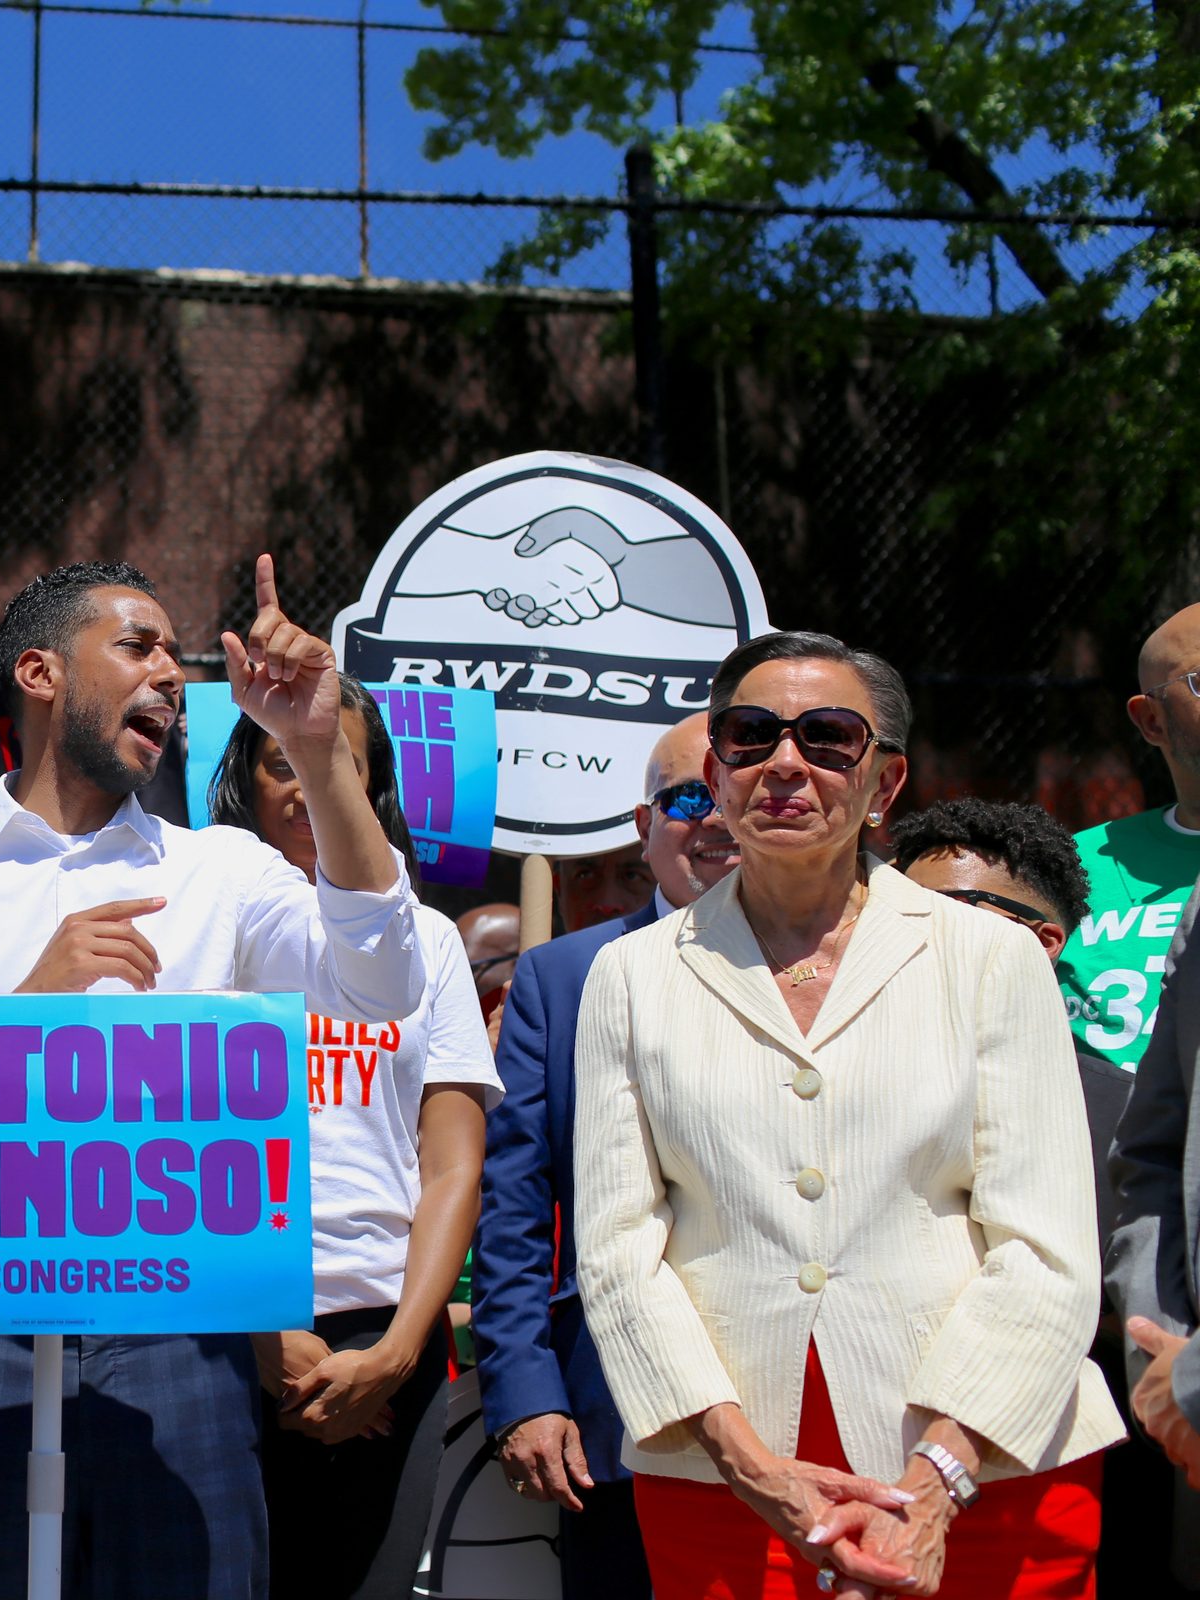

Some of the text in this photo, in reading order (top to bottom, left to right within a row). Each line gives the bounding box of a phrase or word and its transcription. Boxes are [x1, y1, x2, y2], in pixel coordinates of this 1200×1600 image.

[384, 656, 712, 712] RWDSU
[497, 747, 613, 774] FCW
[1080, 902, 1183, 947] WE
